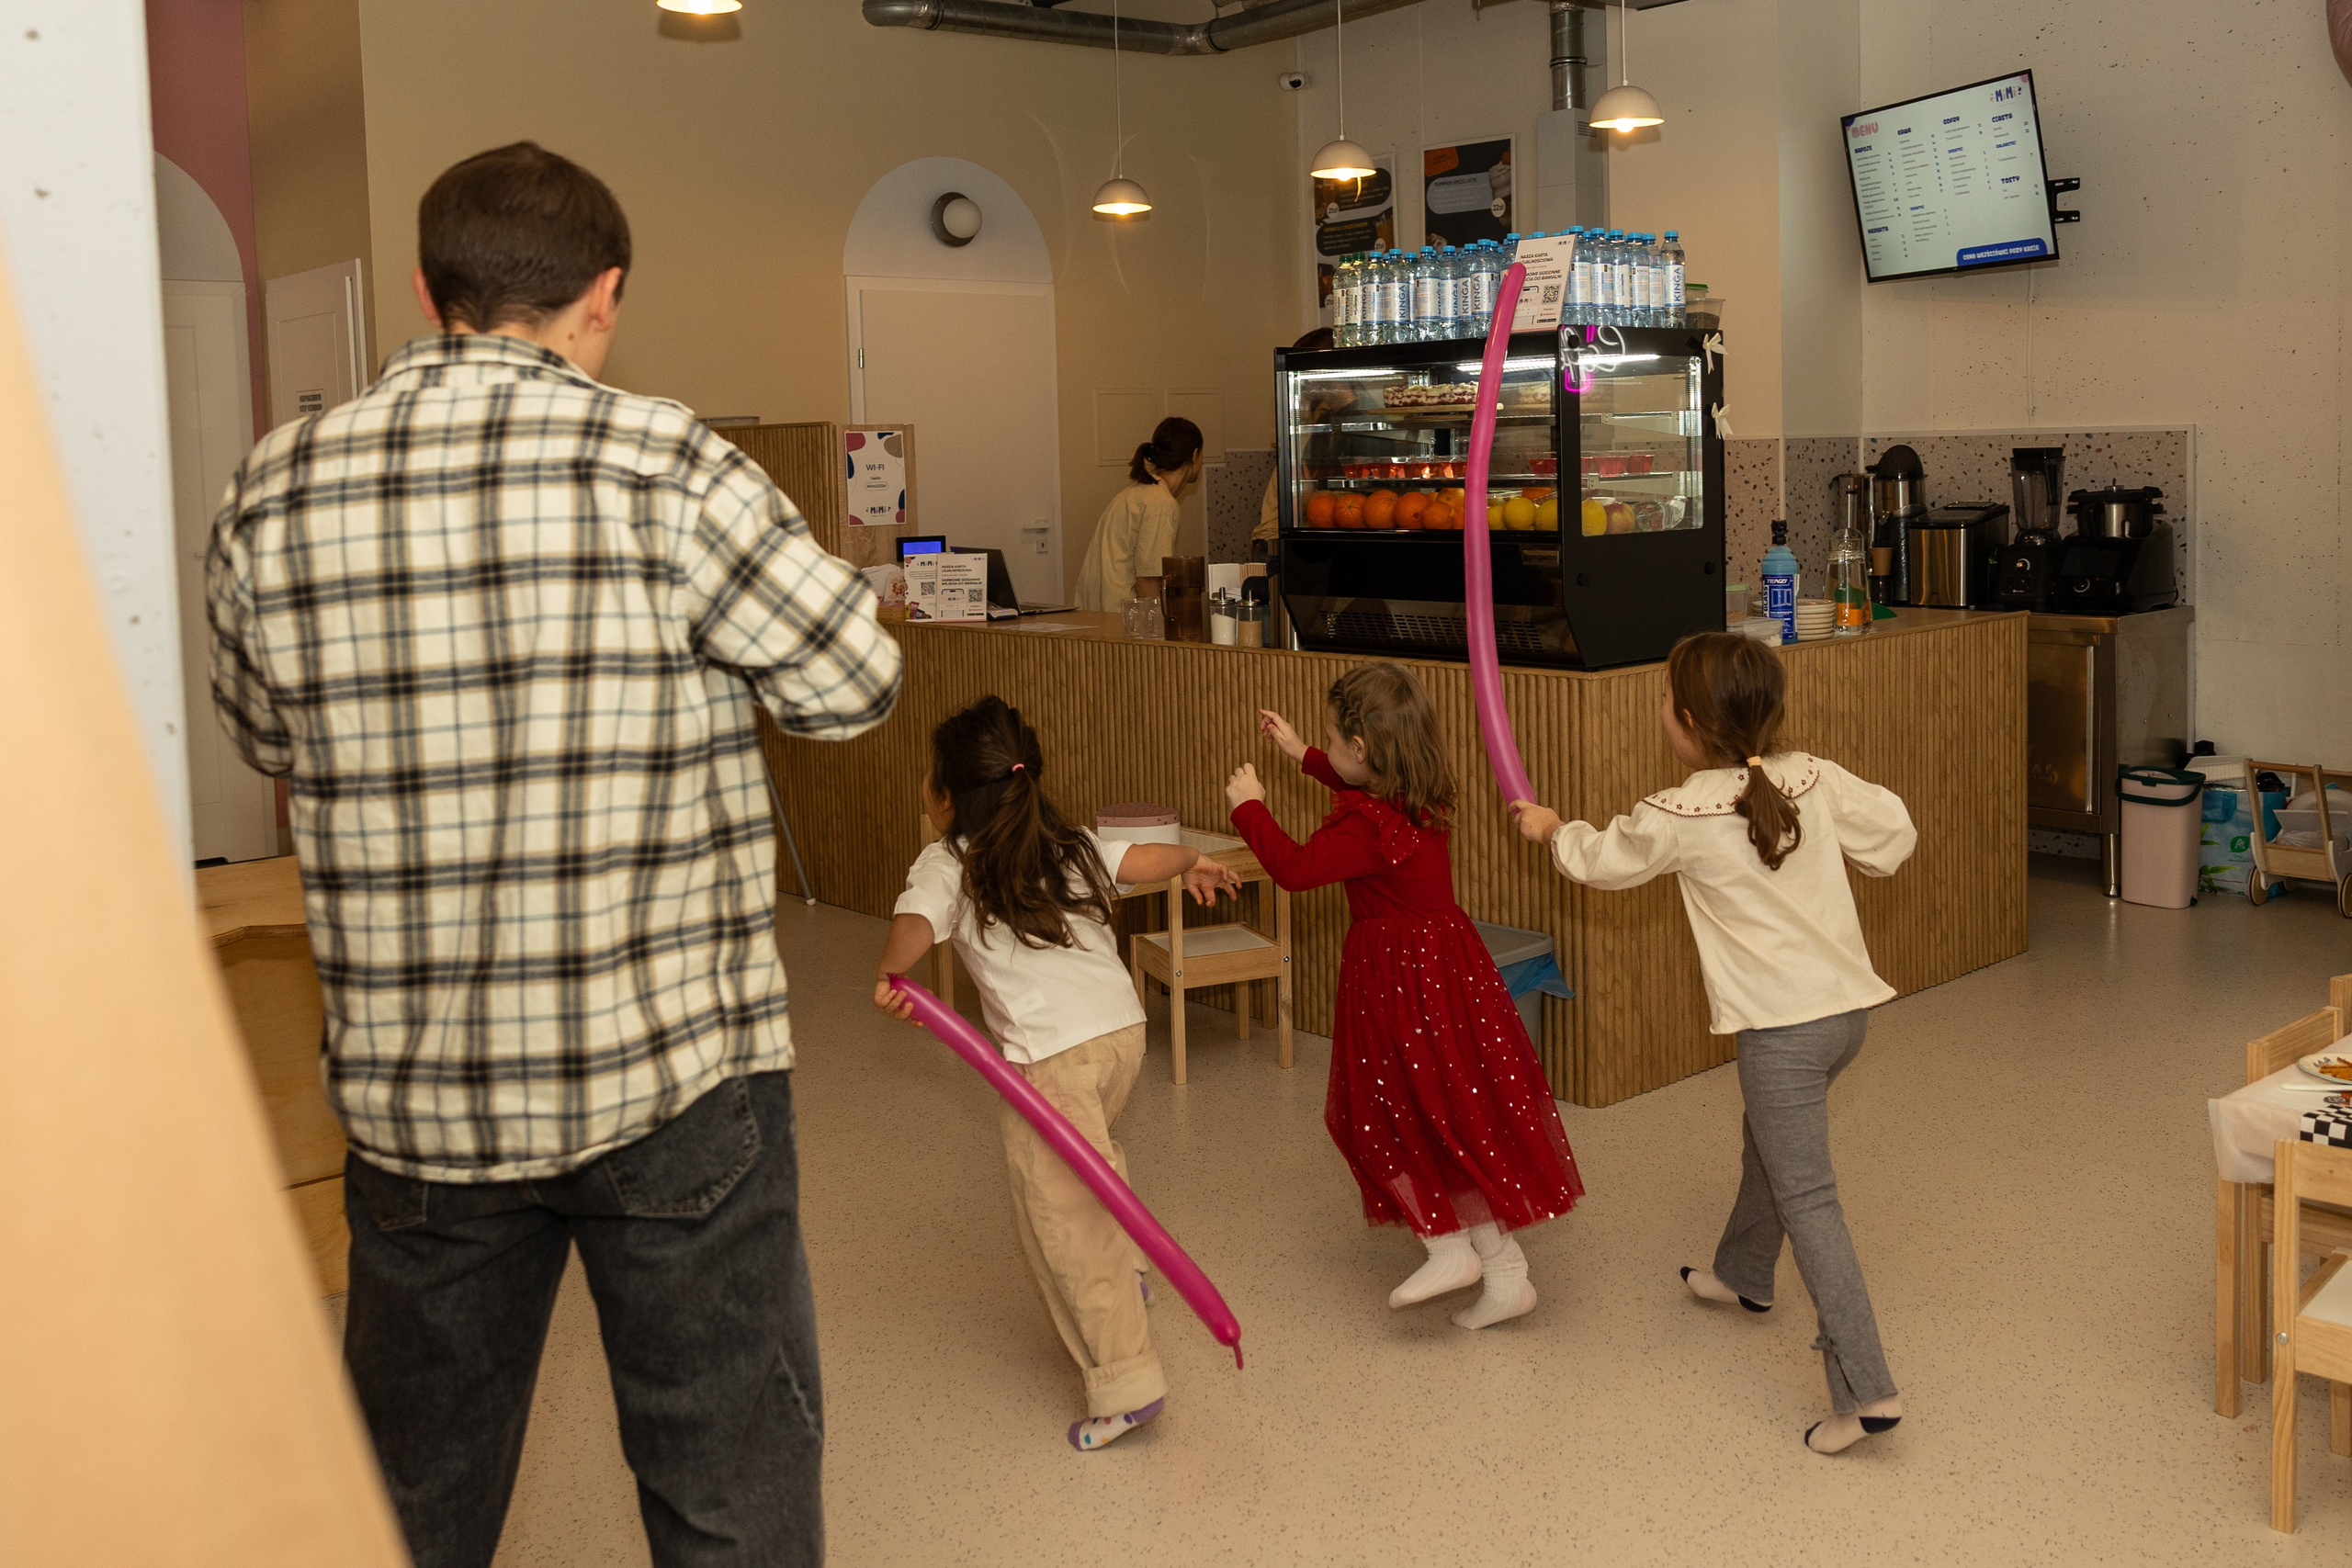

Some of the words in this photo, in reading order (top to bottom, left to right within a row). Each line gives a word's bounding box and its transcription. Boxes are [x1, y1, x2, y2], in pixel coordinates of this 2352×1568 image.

[1943, 116, 1960, 125] GOFRY
[1992, 113, 2013, 122] CIASTA
[1851, 121, 1879, 139] MENU
[2001, 175, 2020, 184] TOSTY
